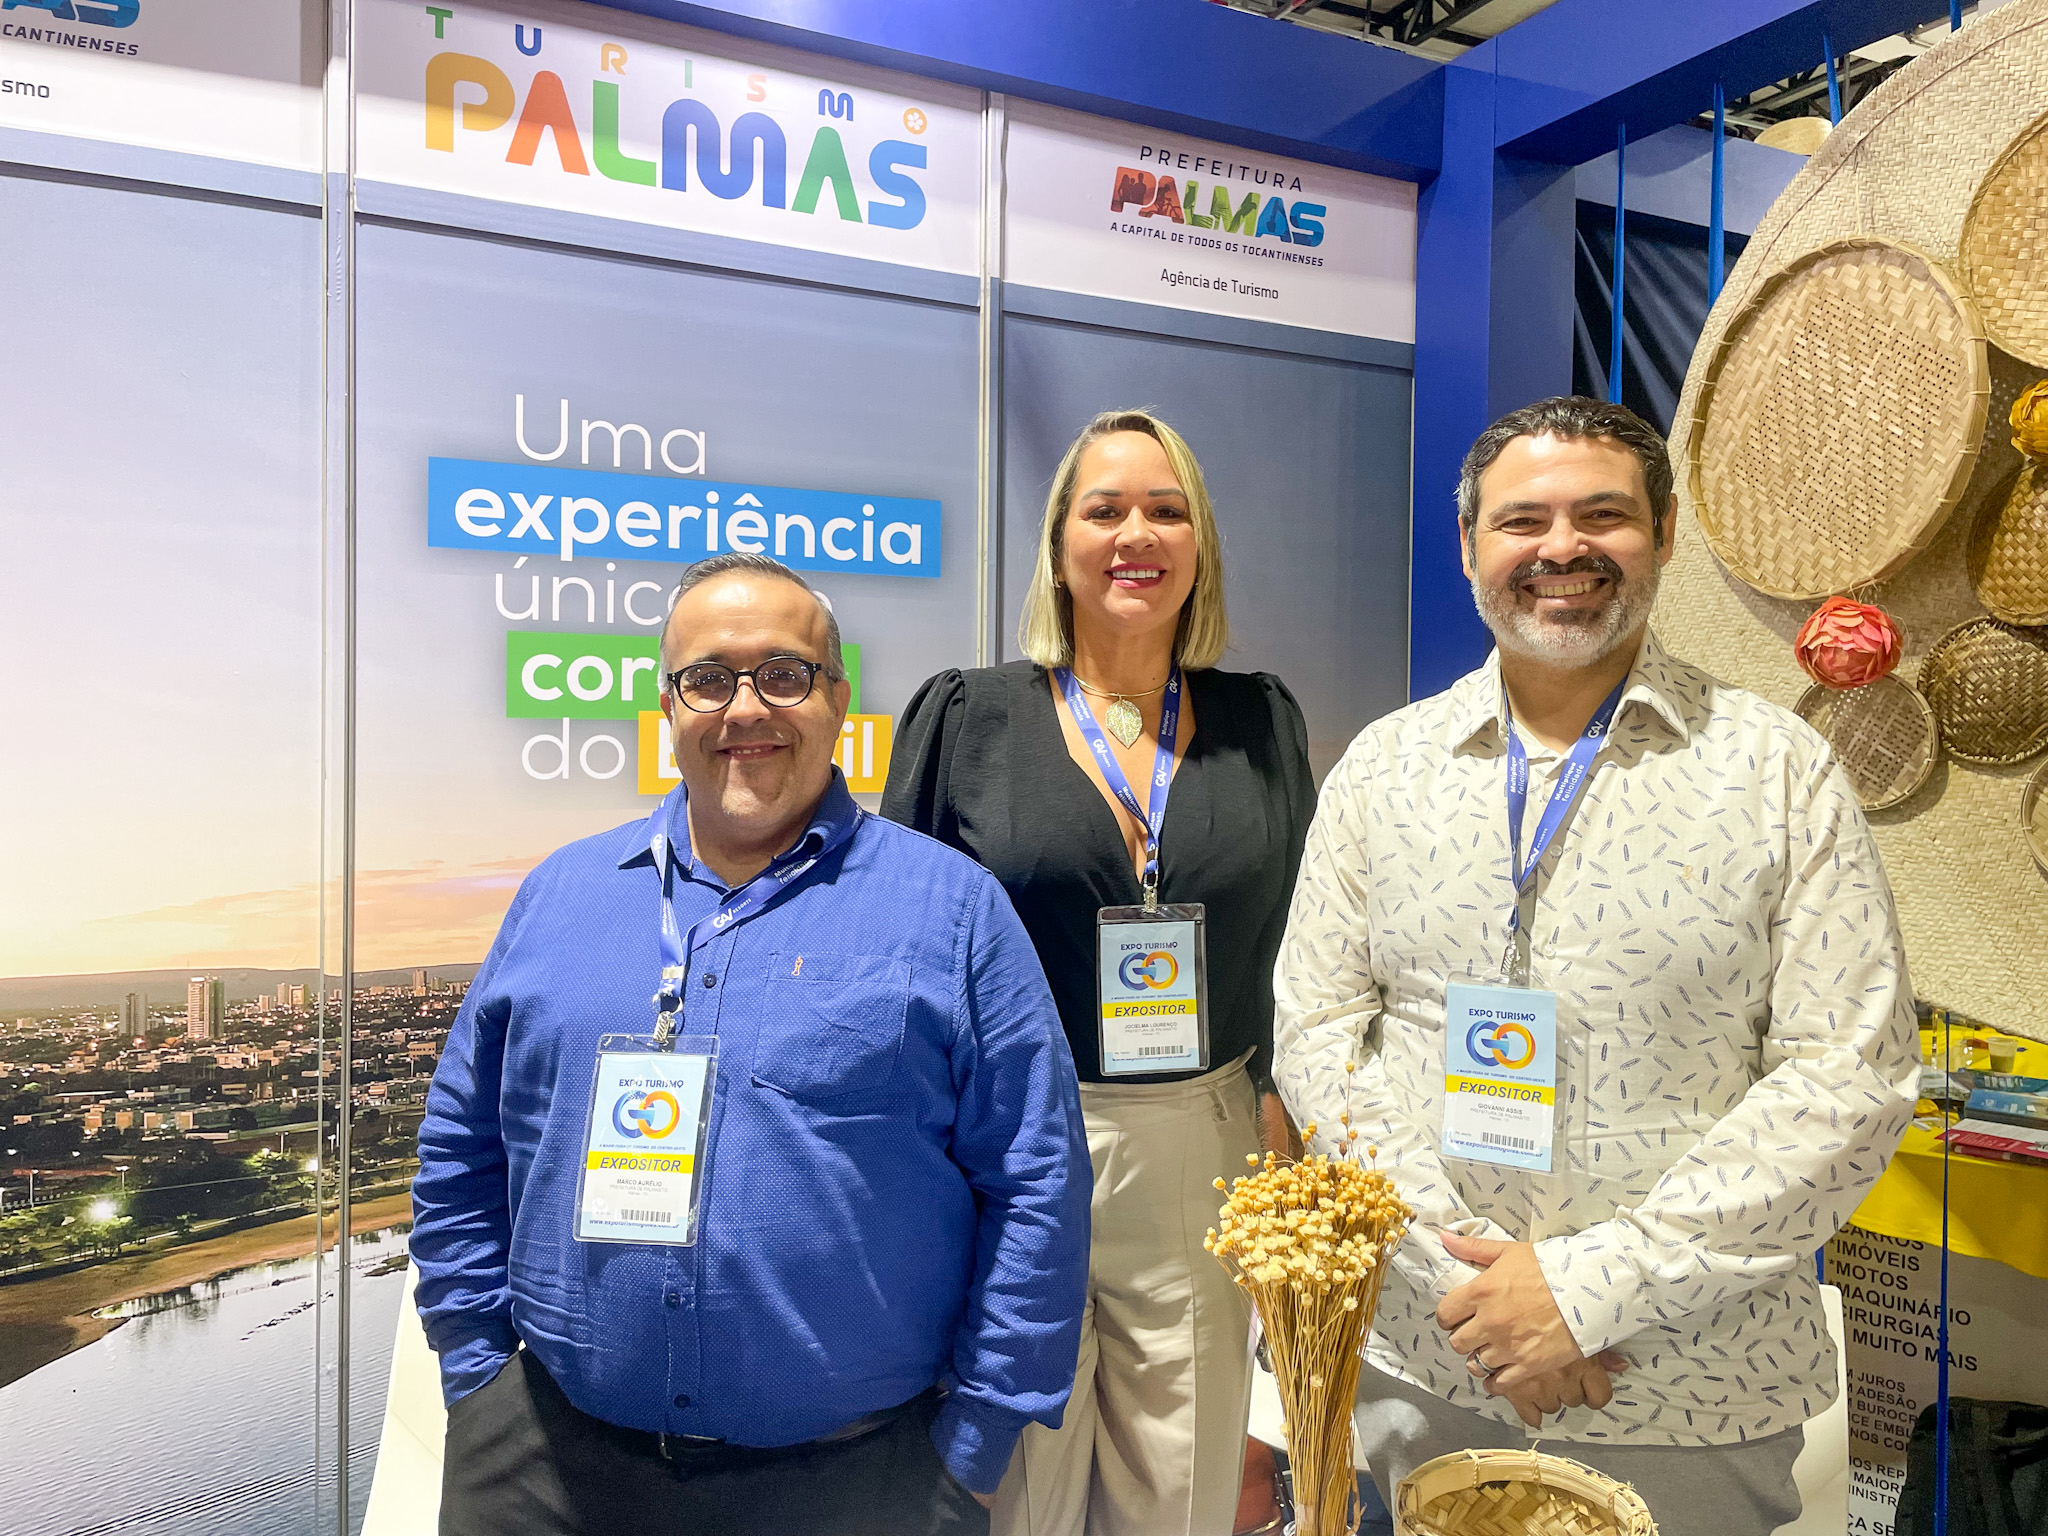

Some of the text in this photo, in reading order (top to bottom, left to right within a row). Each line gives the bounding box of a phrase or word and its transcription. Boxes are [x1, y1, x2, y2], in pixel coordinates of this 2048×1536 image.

[2, 24, 139, 56] CANTINENSES
[1, 79, 50, 98] smo
[425, 51, 928, 230] PALMAS
[1140, 146, 1302, 192] PREFEITURA
[1111, 166, 1327, 247] PALMAS
[1110, 222, 1324, 267] A CAPITAL DE TODOS OS TOCANTINENSES
[1160, 268, 1279, 300] Agência de Turismo
[515, 394, 706, 475] Uma
[454, 487, 922, 566] experiência
[495, 556, 668, 627] únic
[521, 653, 657, 702] cor
[1587, 720, 1604, 739] GAV
[521, 718, 626, 781] do
[1555, 762, 1577, 801] Multiplique
[1561, 764, 1585, 802] felicidade
[712, 908, 734, 929] GAV
[1120, 941, 1178, 951] EXPO TURISMO
[1115, 1004, 1186, 1017] EXPOSITOR
[1468, 1008, 1536, 1022] EXPO TURISMO
[618, 1078, 684, 1089] EXPO TURISMO
[1459, 1081, 1542, 1103] EXPOSITOR
[1478, 1103, 1505, 1112] GIOVANNI
[600, 1157, 681, 1172] EXPOSITOR
[1843, 1304, 1949, 1341] IRURGIA
[1853, 1328, 1978, 1371] MUITO MAIS
[1857, 1372, 1906, 1393] JUROS
[1857, 1386, 1917, 1410] ADESÃO
[1857, 1400, 1918, 1424] BUROCR
[1850, 1427, 1879, 1445] NOS
[1876, 1464, 1905, 1479] REP
[1849, 1484, 1897, 1508] INISTR
